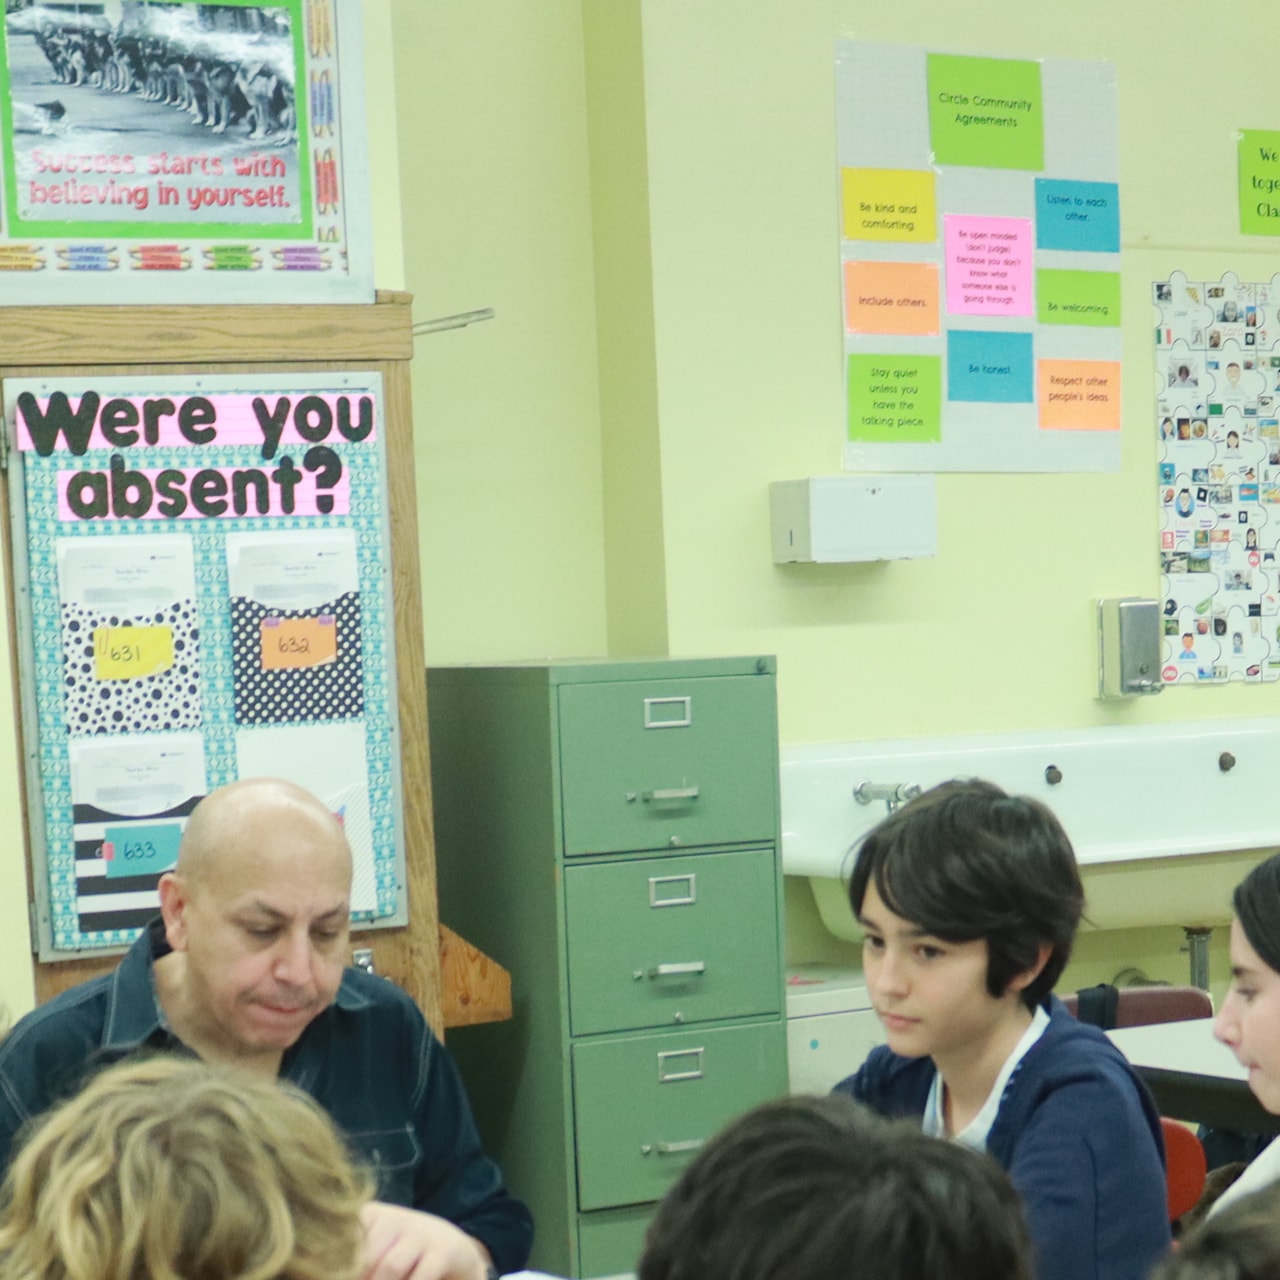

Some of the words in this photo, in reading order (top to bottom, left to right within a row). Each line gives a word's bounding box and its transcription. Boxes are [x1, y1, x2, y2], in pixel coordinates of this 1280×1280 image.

[938, 92, 970, 106] Circle
[972, 95, 1033, 112] Community
[954, 113, 1018, 128] Agreements
[1259, 147, 1279, 162] We
[31, 151, 136, 175] Success
[147, 152, 224, 176] starts
[232, 152, 286, 178] with
[29, 178, 149, 211] believing
[157, 181, 180, 206] in
[186, 184, 291, 211] yourself.
[860, 202, 872, 213] Be
[874, 203, 896, 214] kind
[898, 204, 918, 215] and
[859, 295, 894, 307] Include
[871, 366, 891, 379] Stay
[893, 367, 918, 380] quiet
[969, 363, 981, 374] Be
[869, 383, 898, 395] unless
[901, 385, 918, 396] you
[873, 399, 897, 411] have
[899, 399, 915, 411] the
[18, 388, 218, 457] Were
[251, 395, 374, 461] you
[861, 415, 894, 428] talking
[66, 445, 343, 519] absent?
[110, 645, 141, 662] 631
[278, 637, 311, 655] 632
[123, 841, 157, 860] 633
